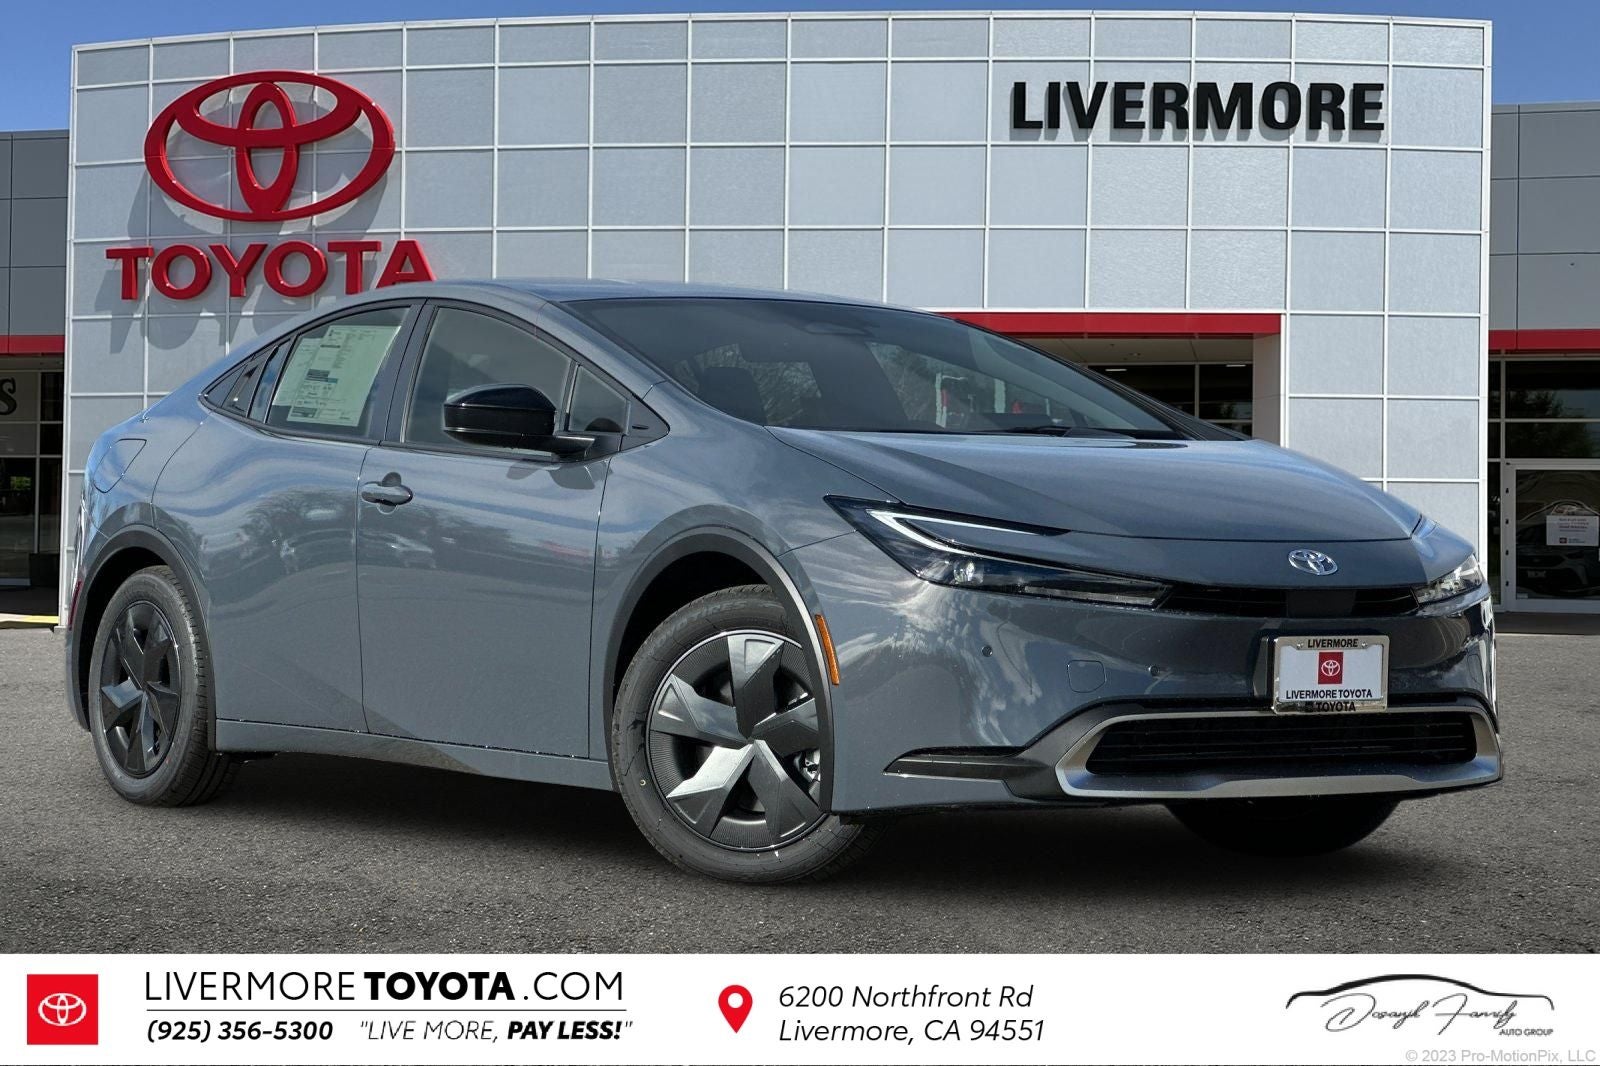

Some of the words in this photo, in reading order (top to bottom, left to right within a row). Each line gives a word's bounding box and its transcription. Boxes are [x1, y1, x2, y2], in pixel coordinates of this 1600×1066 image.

[1012, 81, 1385, 131] LIVERMORE
[106, 239, 436, 301] TOYOTA
[1308, 638, 1359, 649] LIVERMORE
[1286, 689, 1337, 700] LIVERMORE
[1338, 688, 1373, 699] TOYOTA
[1315, 701, 1356, 712] TOYOTA
